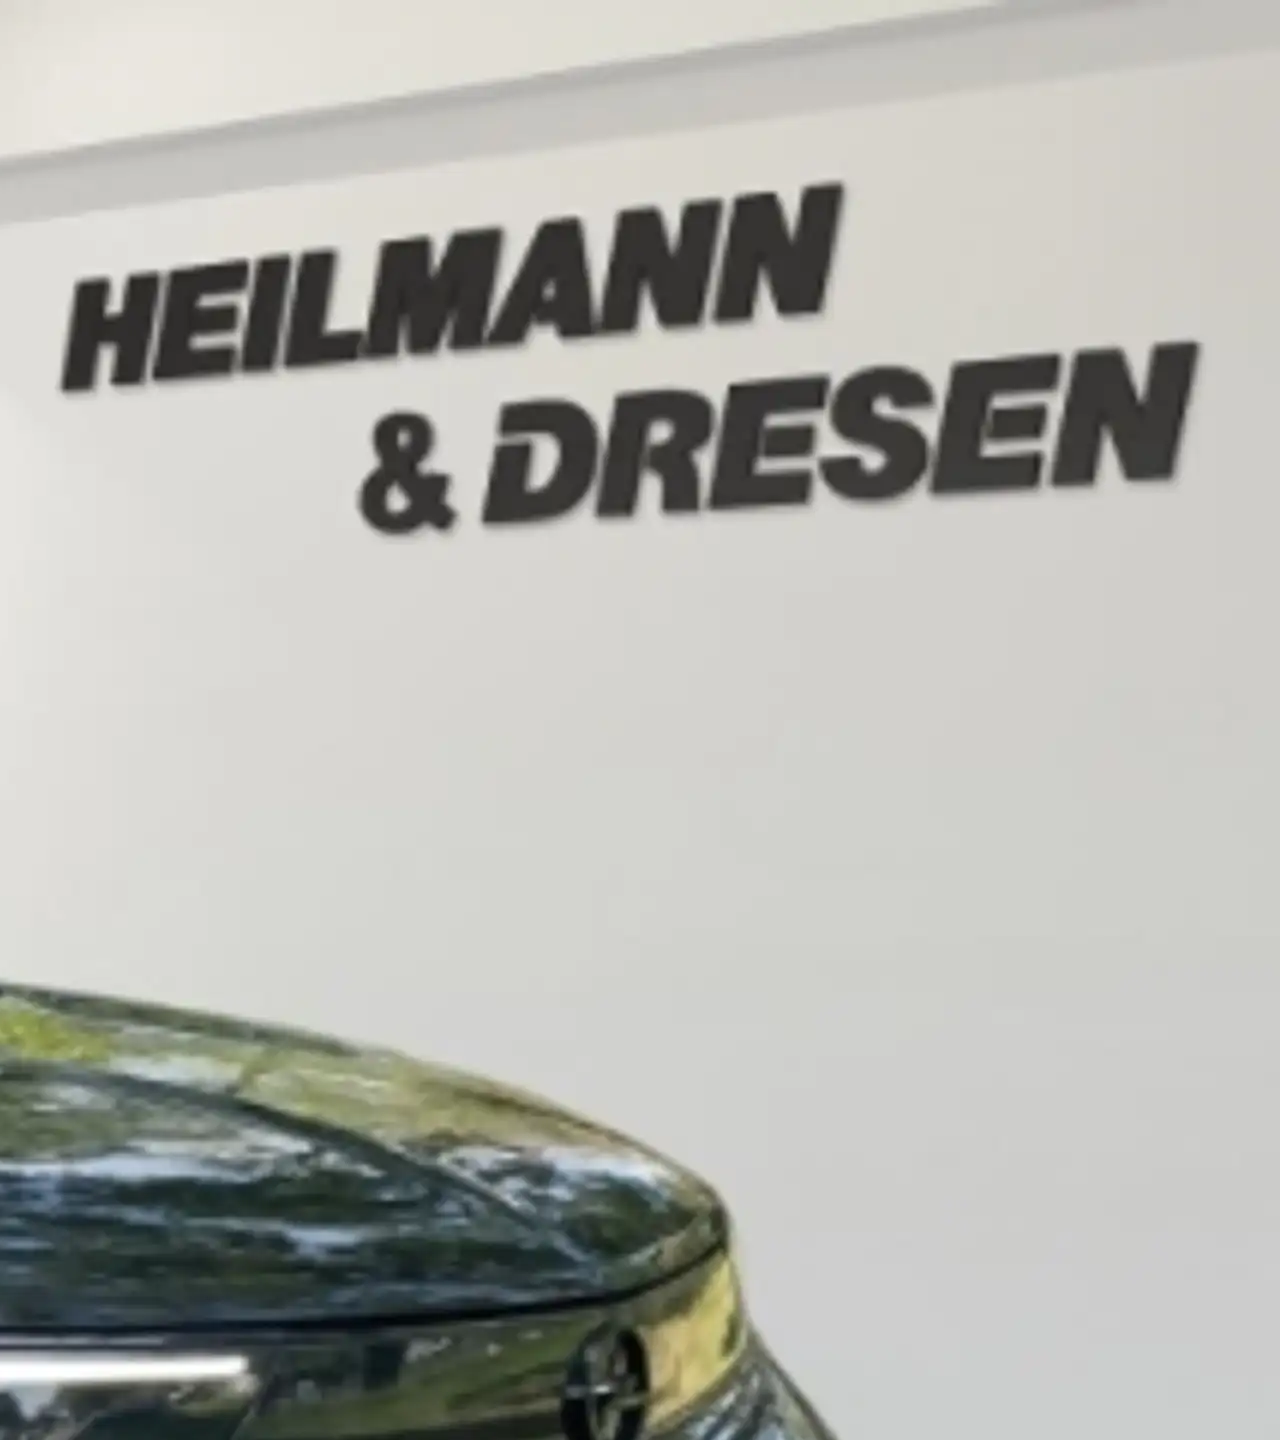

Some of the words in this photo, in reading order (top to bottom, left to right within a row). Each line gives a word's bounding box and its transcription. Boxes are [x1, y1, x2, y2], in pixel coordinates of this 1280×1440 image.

[62, 184, 845, 391] HEILMANN
[359, 412, 457, 535] &
[481, 341, 1200, 526] DRESEN
